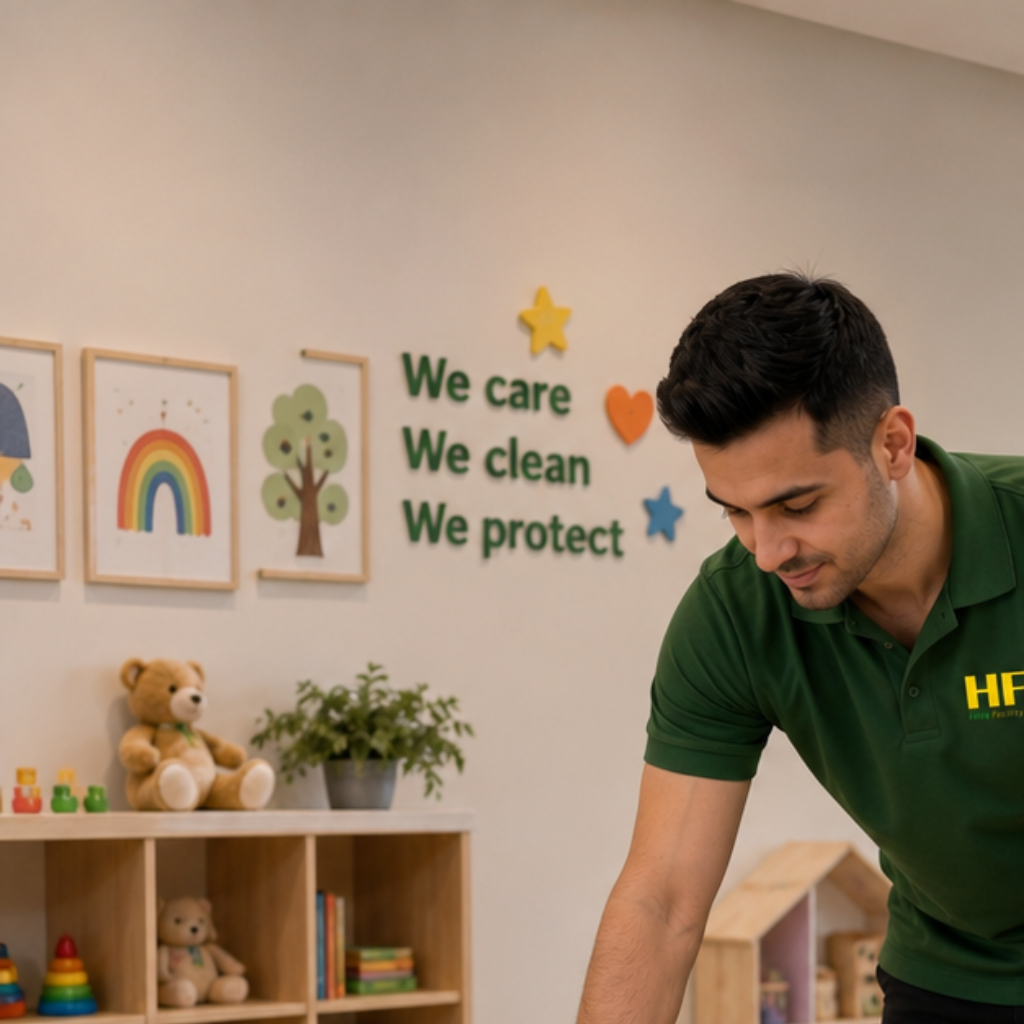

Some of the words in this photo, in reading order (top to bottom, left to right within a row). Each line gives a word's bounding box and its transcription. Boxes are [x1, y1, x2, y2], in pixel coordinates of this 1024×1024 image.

[401, 352, 470, 402] We
[485, 375, 571, 415] care
[402, 426, 470, 474] We
[485, 436, 590, 486] clean
[402, 499, 468, 545] We
[483, 515, 624, 559] protect
